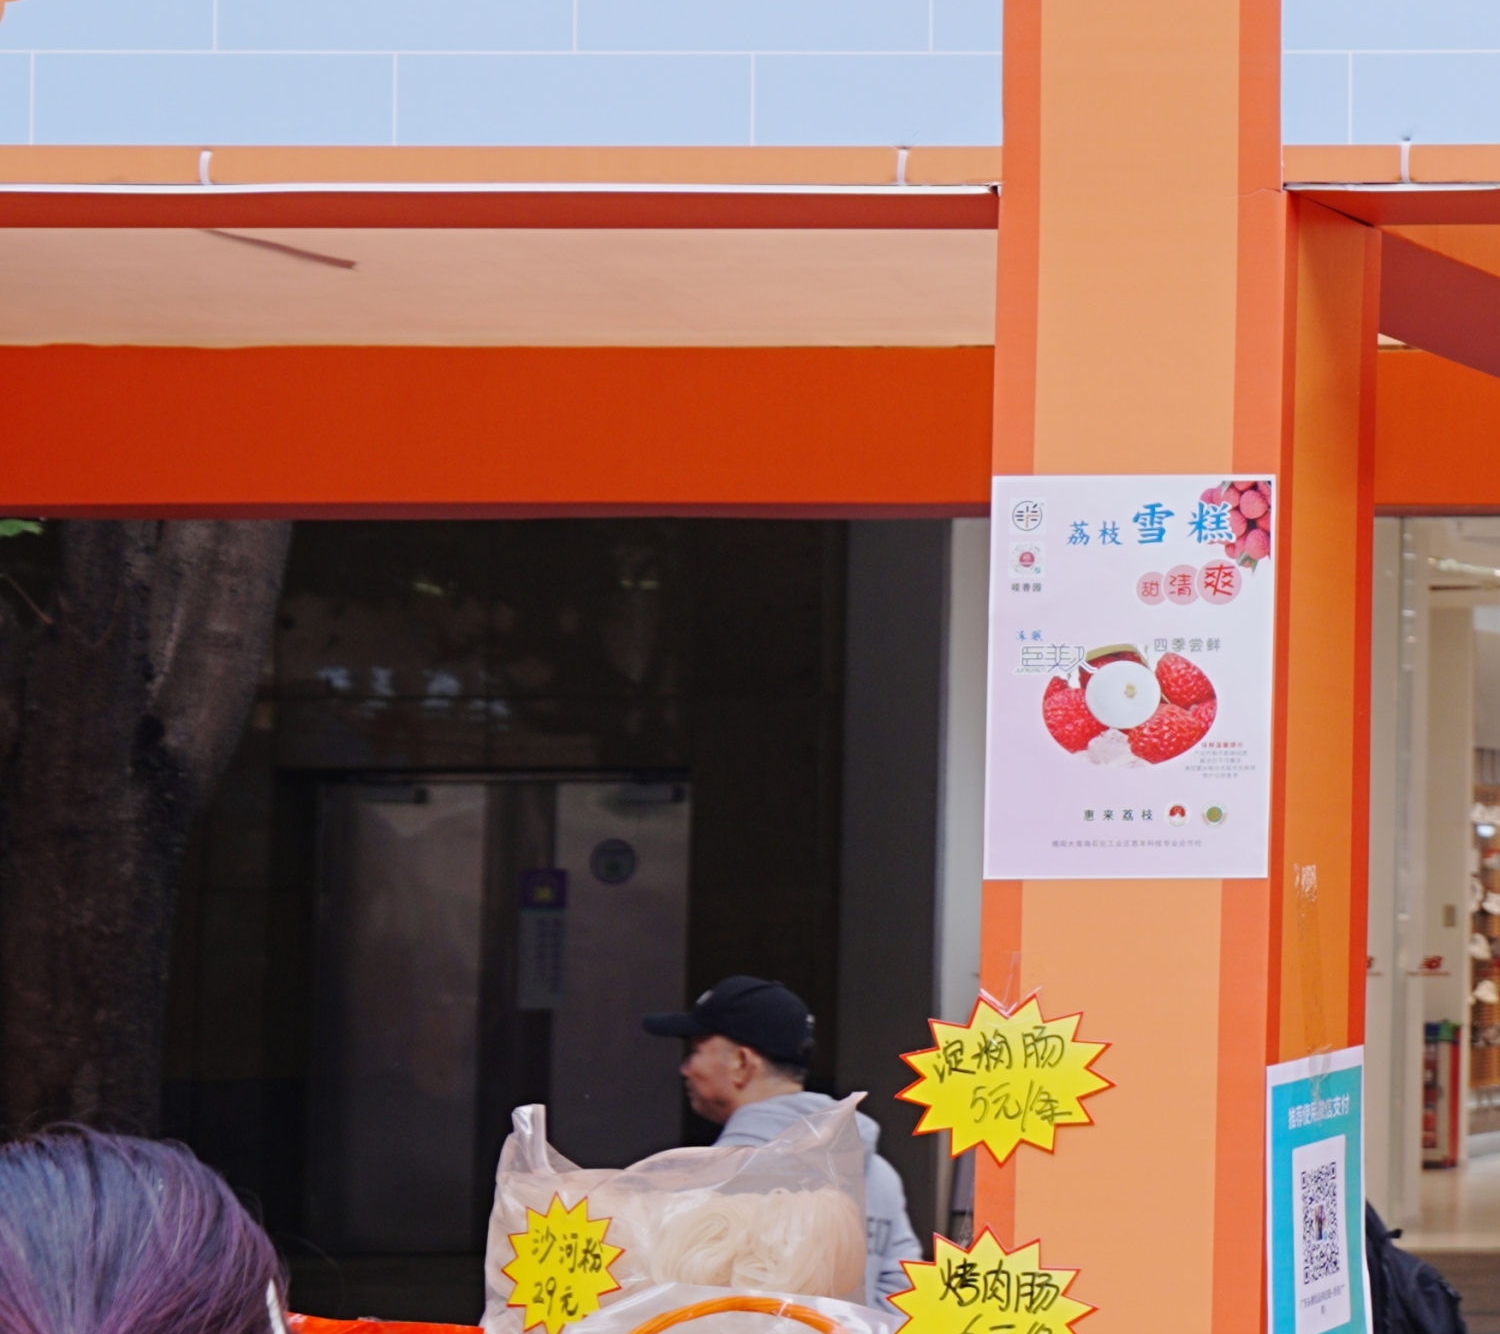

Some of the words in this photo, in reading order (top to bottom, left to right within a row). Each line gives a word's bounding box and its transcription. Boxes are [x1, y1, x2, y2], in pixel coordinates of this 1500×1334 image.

[1066, 502, 1238, 546] 荔枝雪糕
[1140, 564, 1237, 597] 甜清爽
[1153, 637, 1222, 653] 四季尝鲜
[1083, 809, 1154, 821] 惠来荔枝
[970, 1080, 1072, 1131] 5元/条
[1288, 1094, 1351, 1130] 推荐使用微信支付
[532, 1225, 603, 1274] 沙河粉
[533, 1276, 579, 1317] 29元
[939, 1259, 1060, 1314] 烤肉肠
